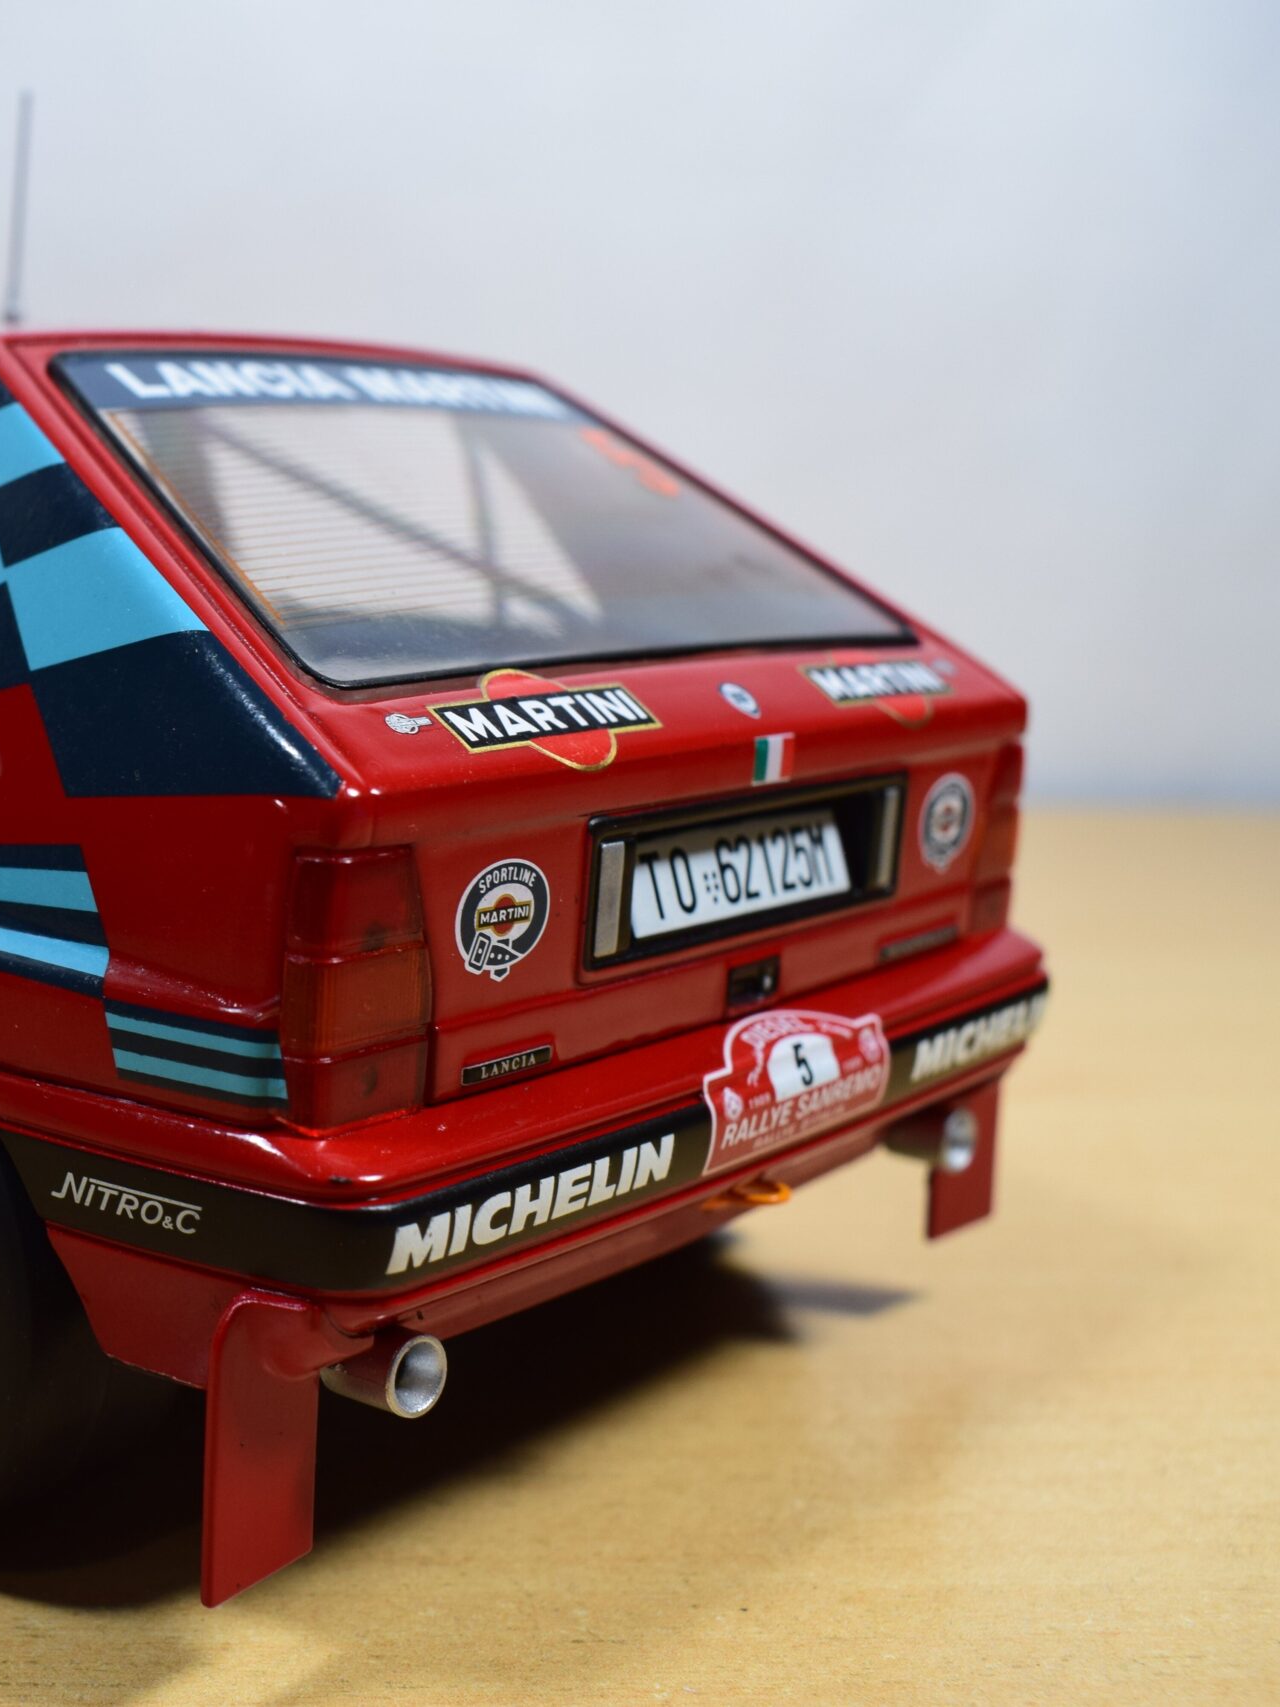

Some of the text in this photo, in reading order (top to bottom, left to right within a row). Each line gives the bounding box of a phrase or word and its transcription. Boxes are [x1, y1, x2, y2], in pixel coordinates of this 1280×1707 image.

[105, 361, 354, 400] LANCIA
[444, 684, 650, 743] MARTINI
[478, 866, 537, 895] SPORTLINE
[638, 846, 698, 921] TO
[480, 906, 530, 925] MARTINI
[481, 1054, 537, 1079] LANCIA
[792, 1041, 814, 1086] 5
[721, 1101, 794, 1150] RALLYE
[385, 1134, 675, 1275] MICHELIN
